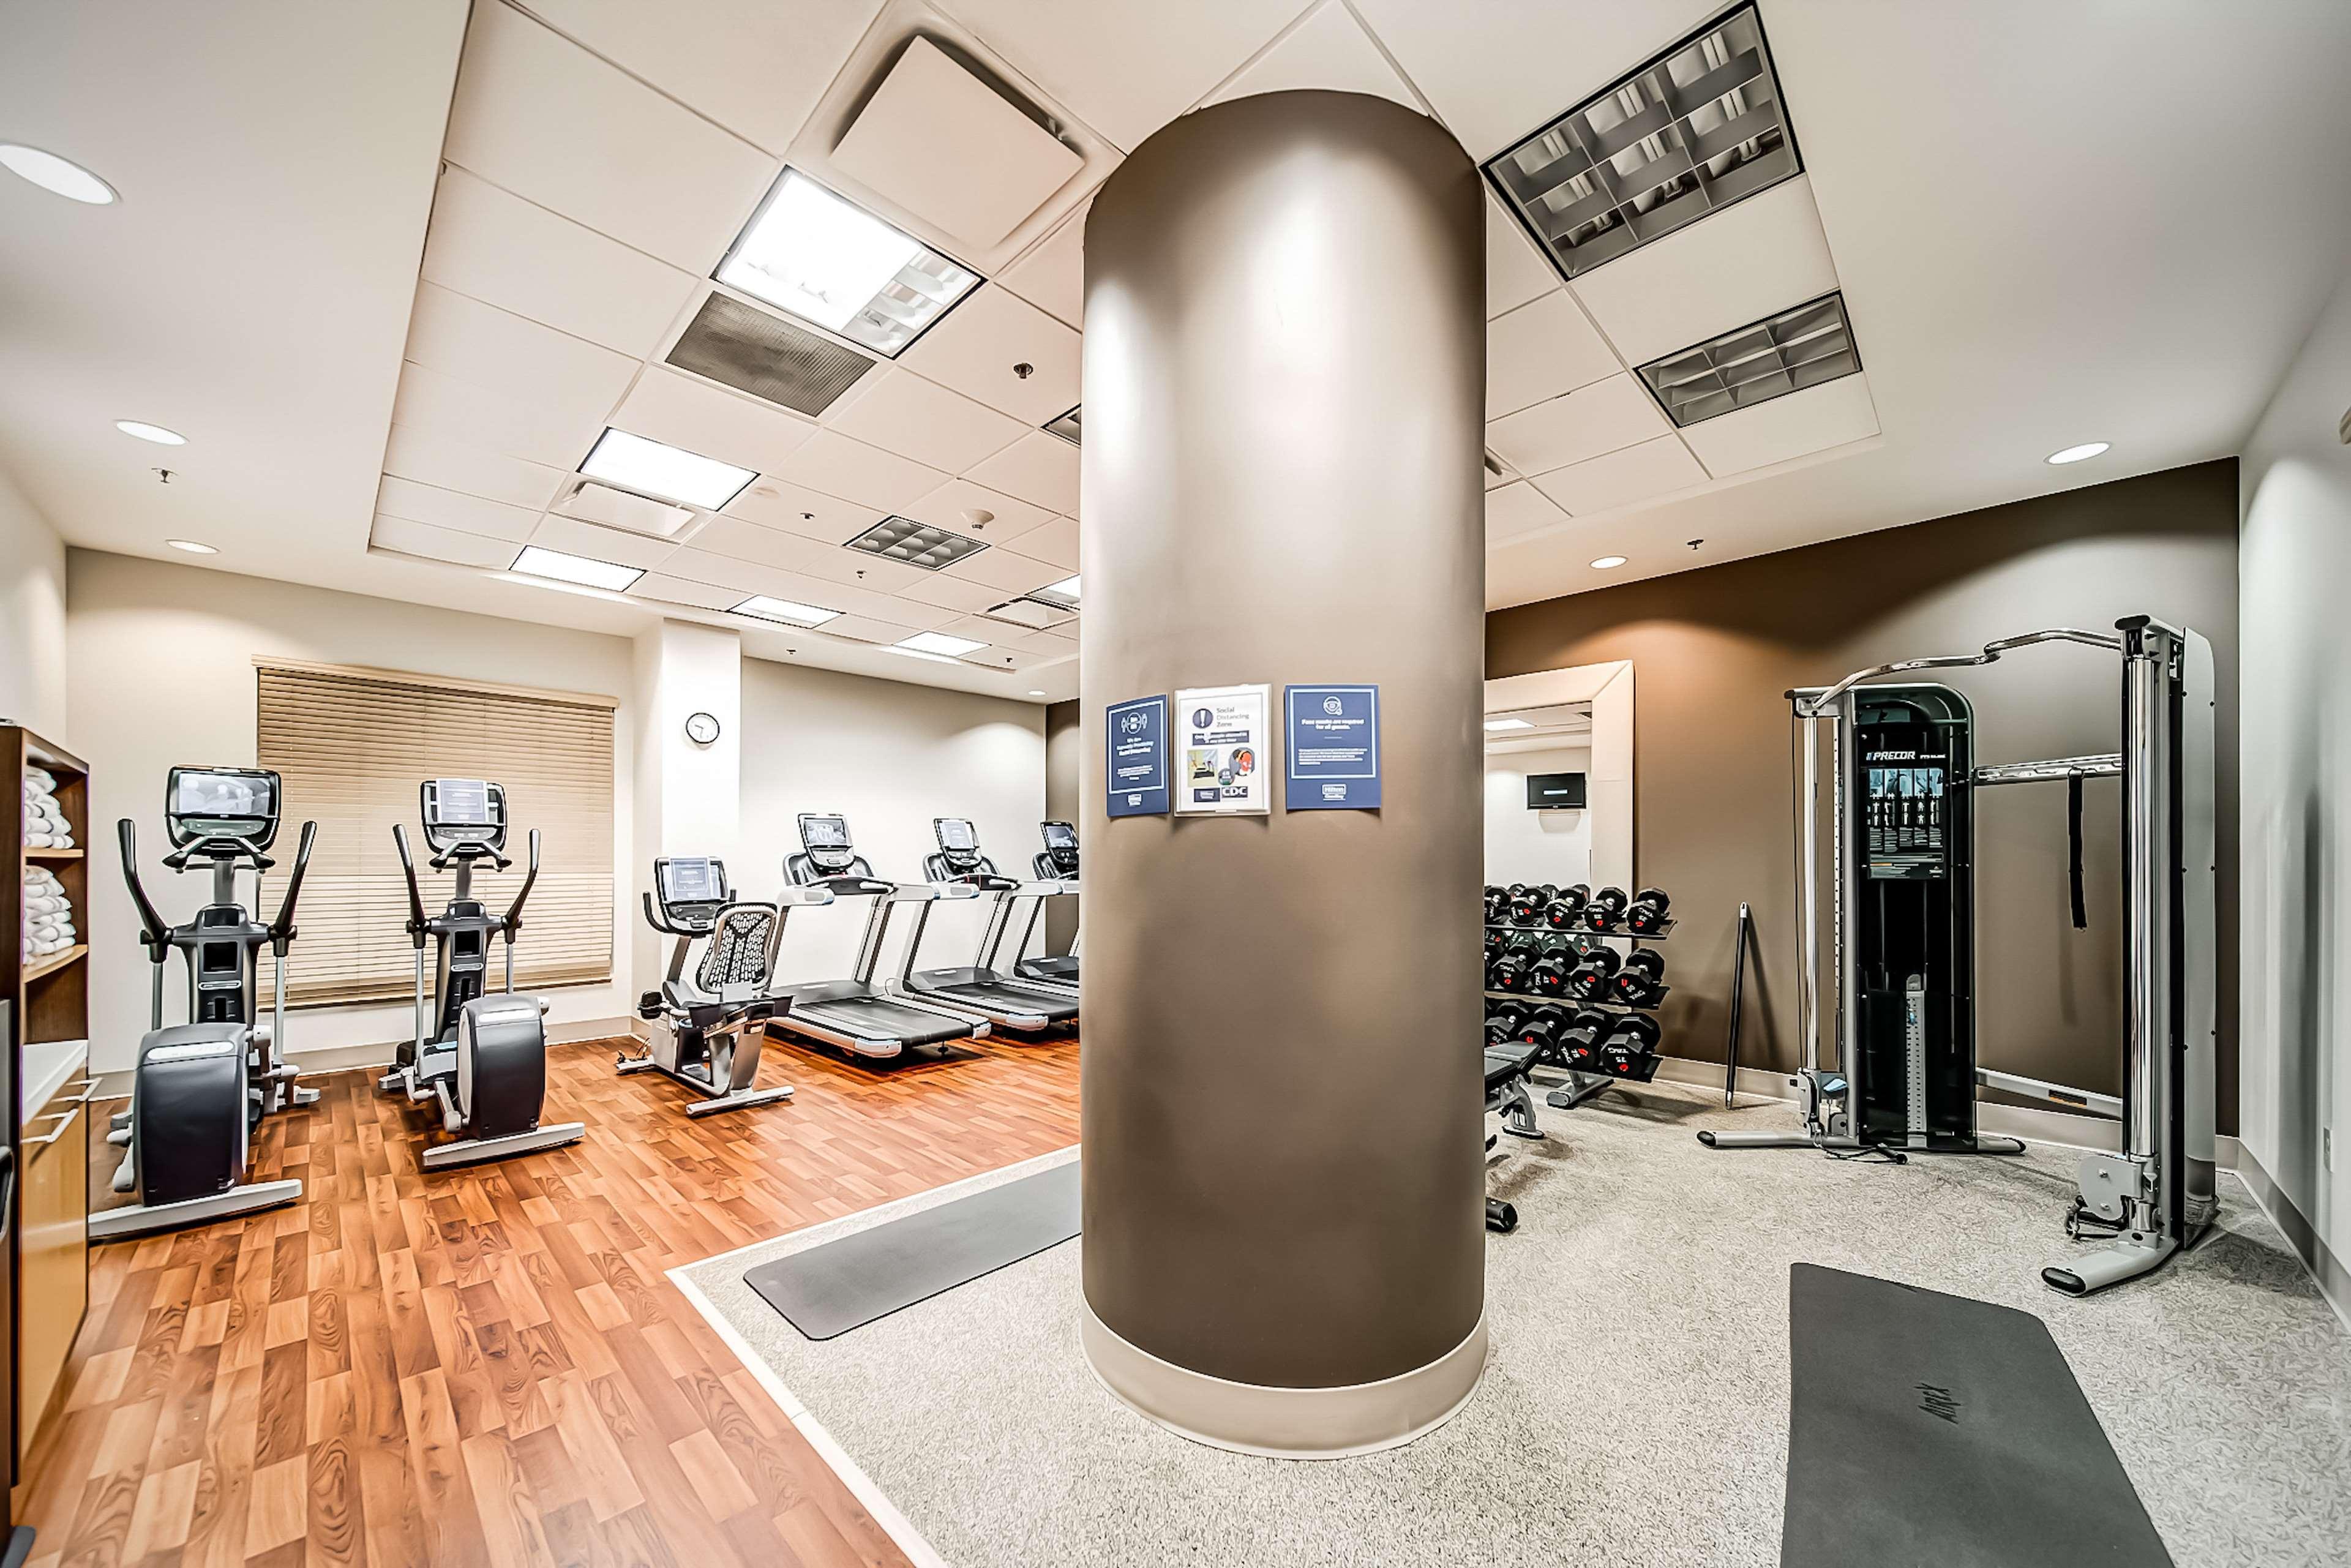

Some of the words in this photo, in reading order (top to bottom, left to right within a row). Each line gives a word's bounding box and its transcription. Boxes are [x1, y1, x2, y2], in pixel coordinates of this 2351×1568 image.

[1873, 751, 1916, 760] PRECOR
[1221, 787, 1247, 797] CDC
[1913, 1382, 1961, 1424] AIREX
